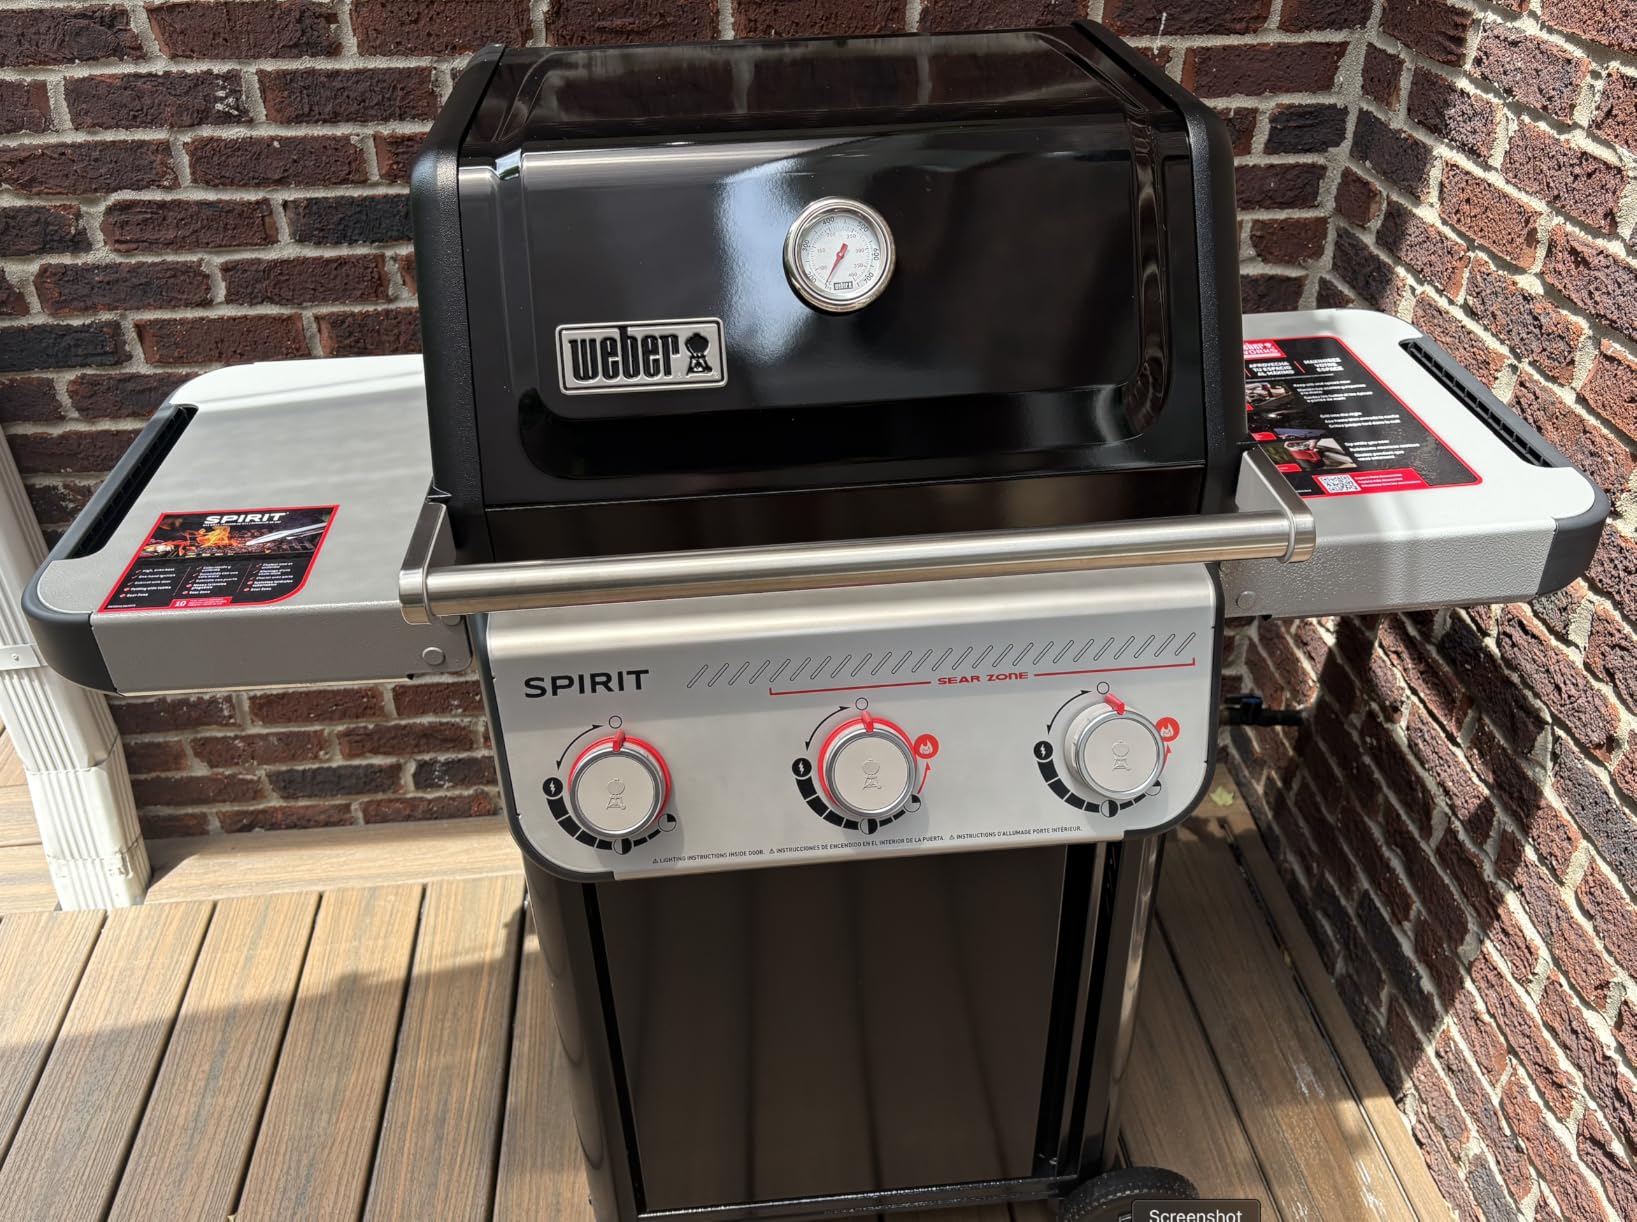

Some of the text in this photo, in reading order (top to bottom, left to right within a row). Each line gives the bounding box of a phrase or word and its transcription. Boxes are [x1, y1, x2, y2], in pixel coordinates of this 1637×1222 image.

[822, 216, 835, 225] 400
[857, 221, 868, 233] 500
[802, 240, 810, 252] 300
[863, 272, 874, 284] 700
[568, 326, 680, 382] weber
[524, 669, 649, 698] SPIRIT
[937, 672, 1029, 685] SEAR ZONE
[659, 855, 686, 863] LIGHTING
[687, 852, 728, 861] INSTRUCTIONS
[776, 844, 820, 853] INSTRUCCIONES
[829, 841, 862, 849] ENCENDIDO
[956, 831, 997, 840] INSTRUCTIONS
[997, 828, 1032, 837] D'ALLUMAGE
[1051, 825, 1083, 833] INTÉRIEUR.
